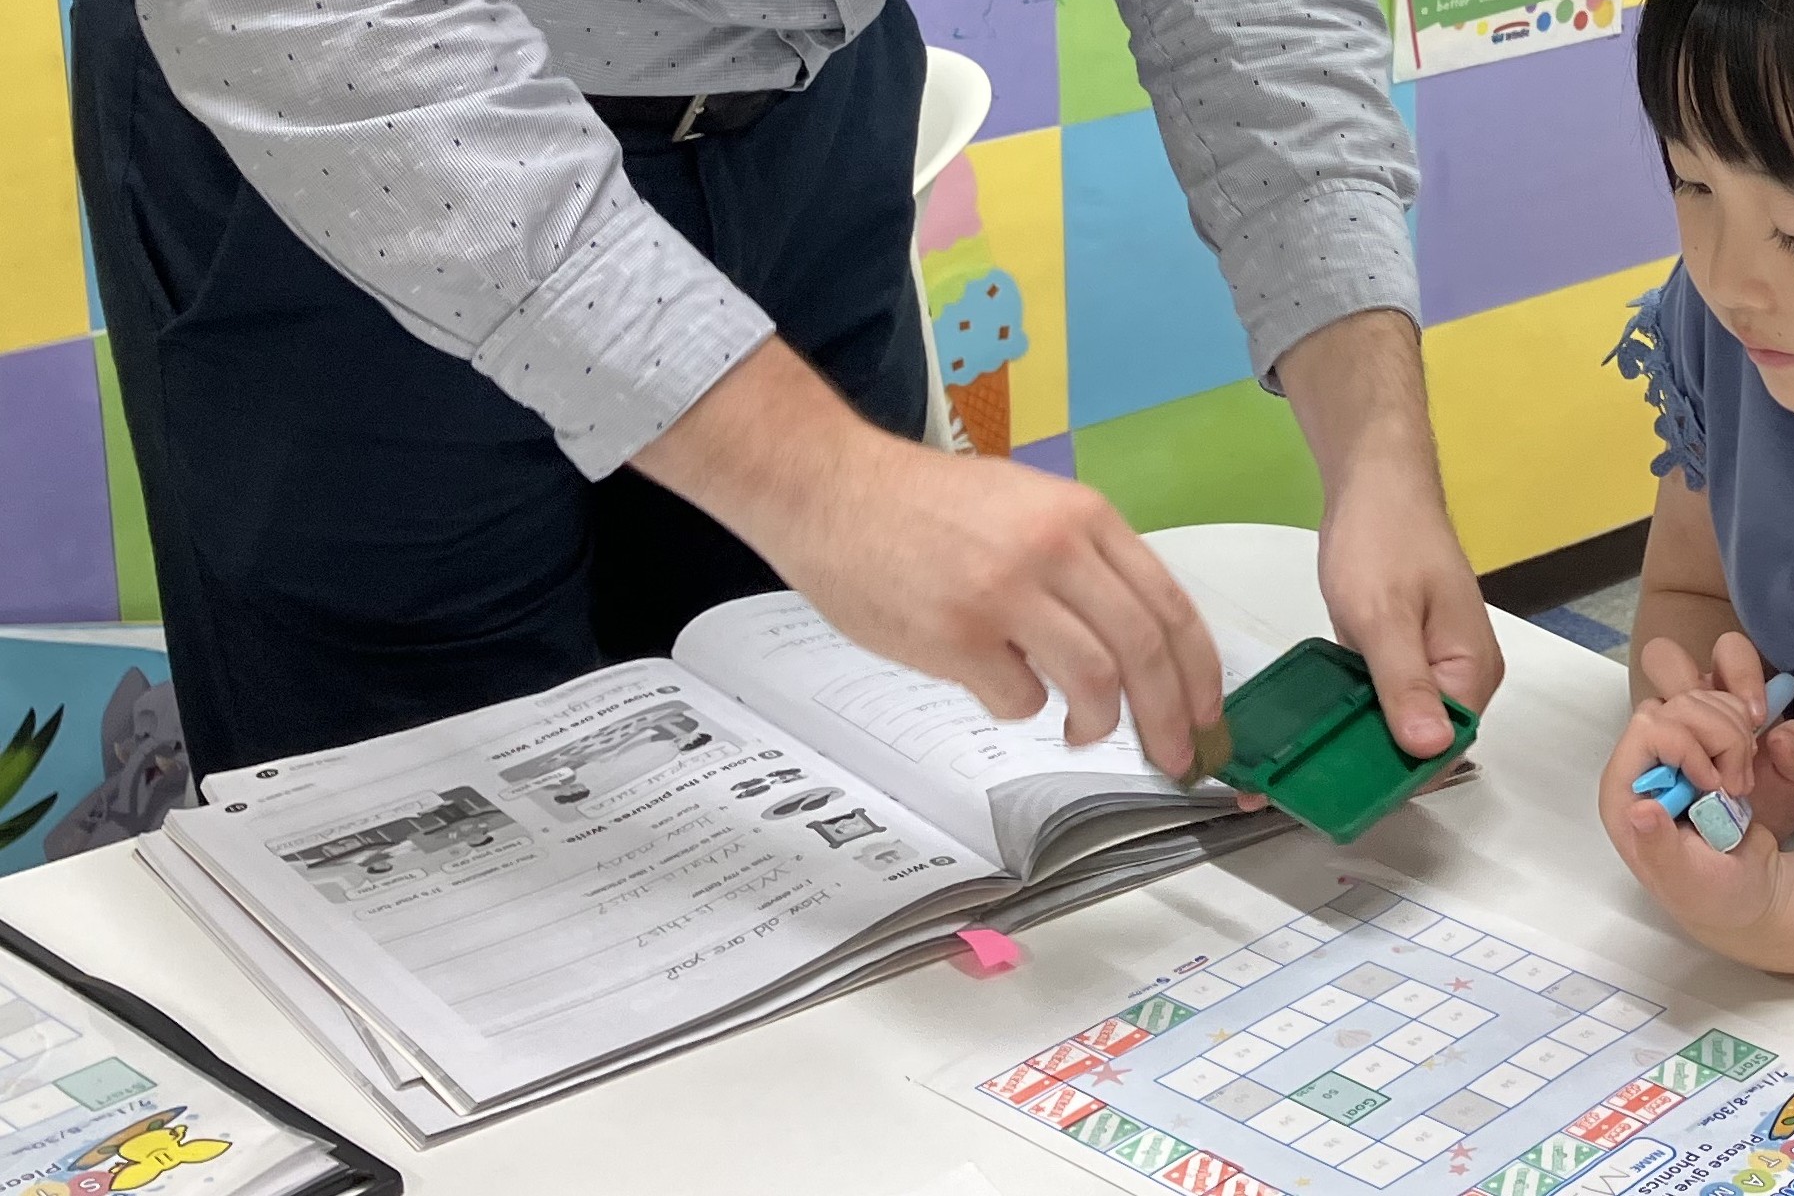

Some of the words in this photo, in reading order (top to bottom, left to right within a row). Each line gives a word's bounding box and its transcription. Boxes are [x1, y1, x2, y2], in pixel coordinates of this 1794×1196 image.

[596, 842, 654, 873] many
[724, 868, 791, 902] Who
[789, 889, 832, 916] How
[752, 917, 780, 938] old
[712, 935, 746, 955] are
[667, 952, 706, 981] you?
[1733, 1053, 1769, 1076] Start
[1341, 1097, 1377, 1121] Goal
[1698, 1144, 1713, 1152] a
[1708, 1134, 1764, 1168] Please
[1629, 1150, 1666, 1173] NAME
[1638, 1151, 1700, 1195] phonics
[1674, 1168, 1709, 1192] give
